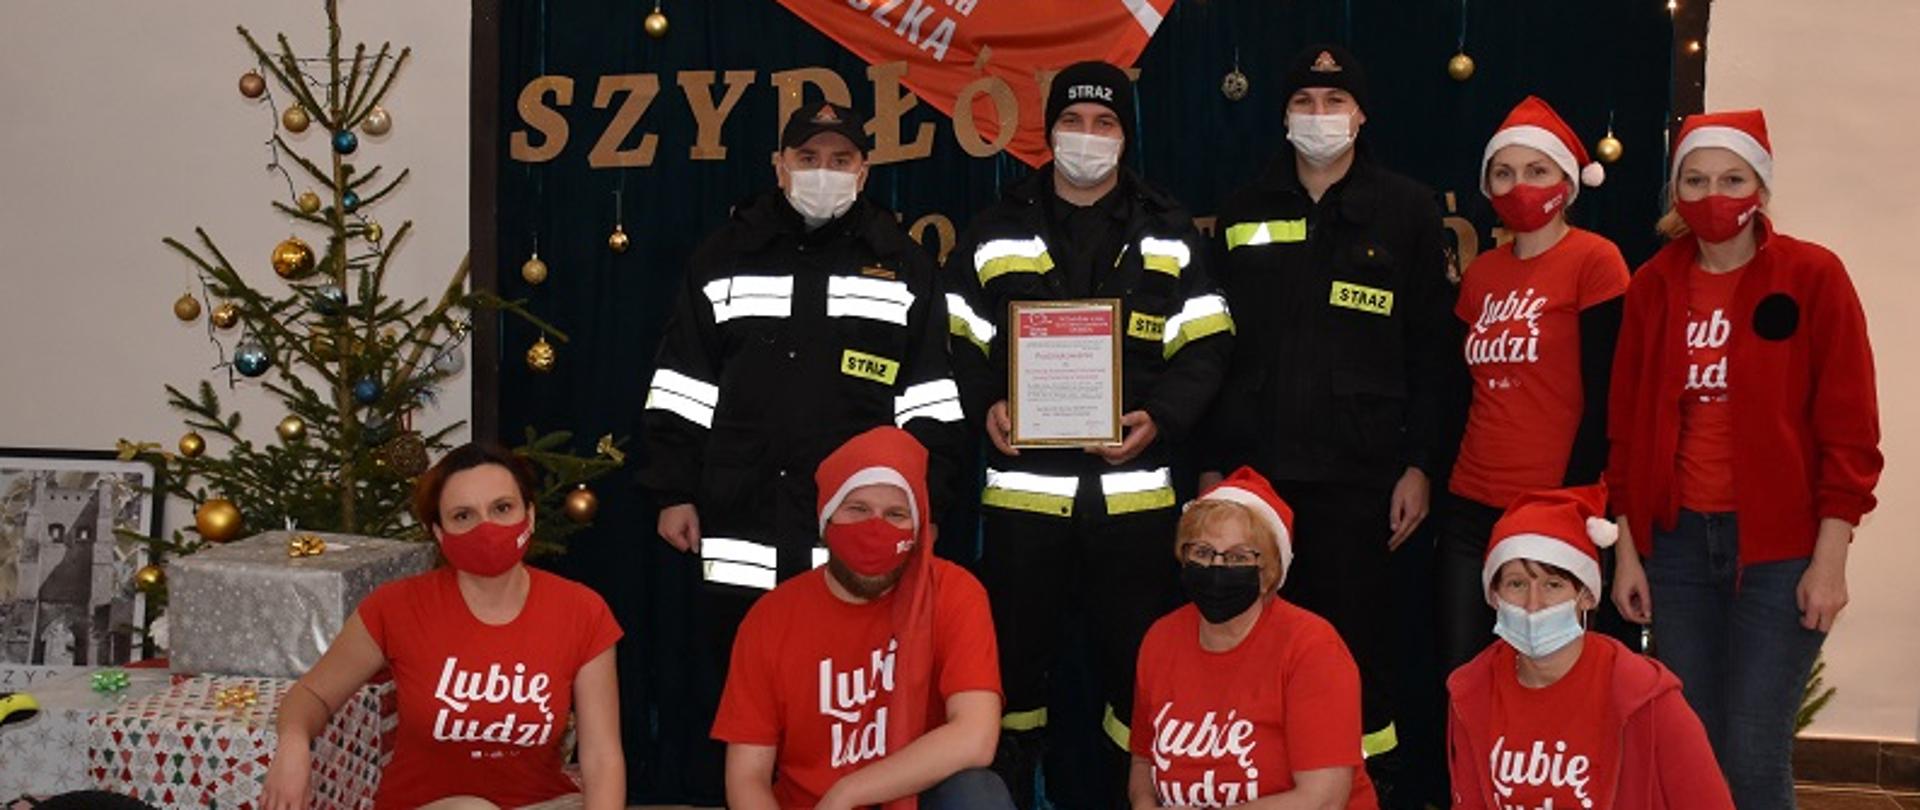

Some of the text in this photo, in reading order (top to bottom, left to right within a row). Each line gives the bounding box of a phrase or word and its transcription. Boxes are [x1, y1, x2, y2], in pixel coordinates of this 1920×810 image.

[510, 44, 1140, 169] SZYDŁÓ
[1475, 288, 1547, 334] Lubię
[434, 656, 551, 713] Lubię
[819, 638, 898, 723] Lubi
[432, 708, 555, 747] ludzi
